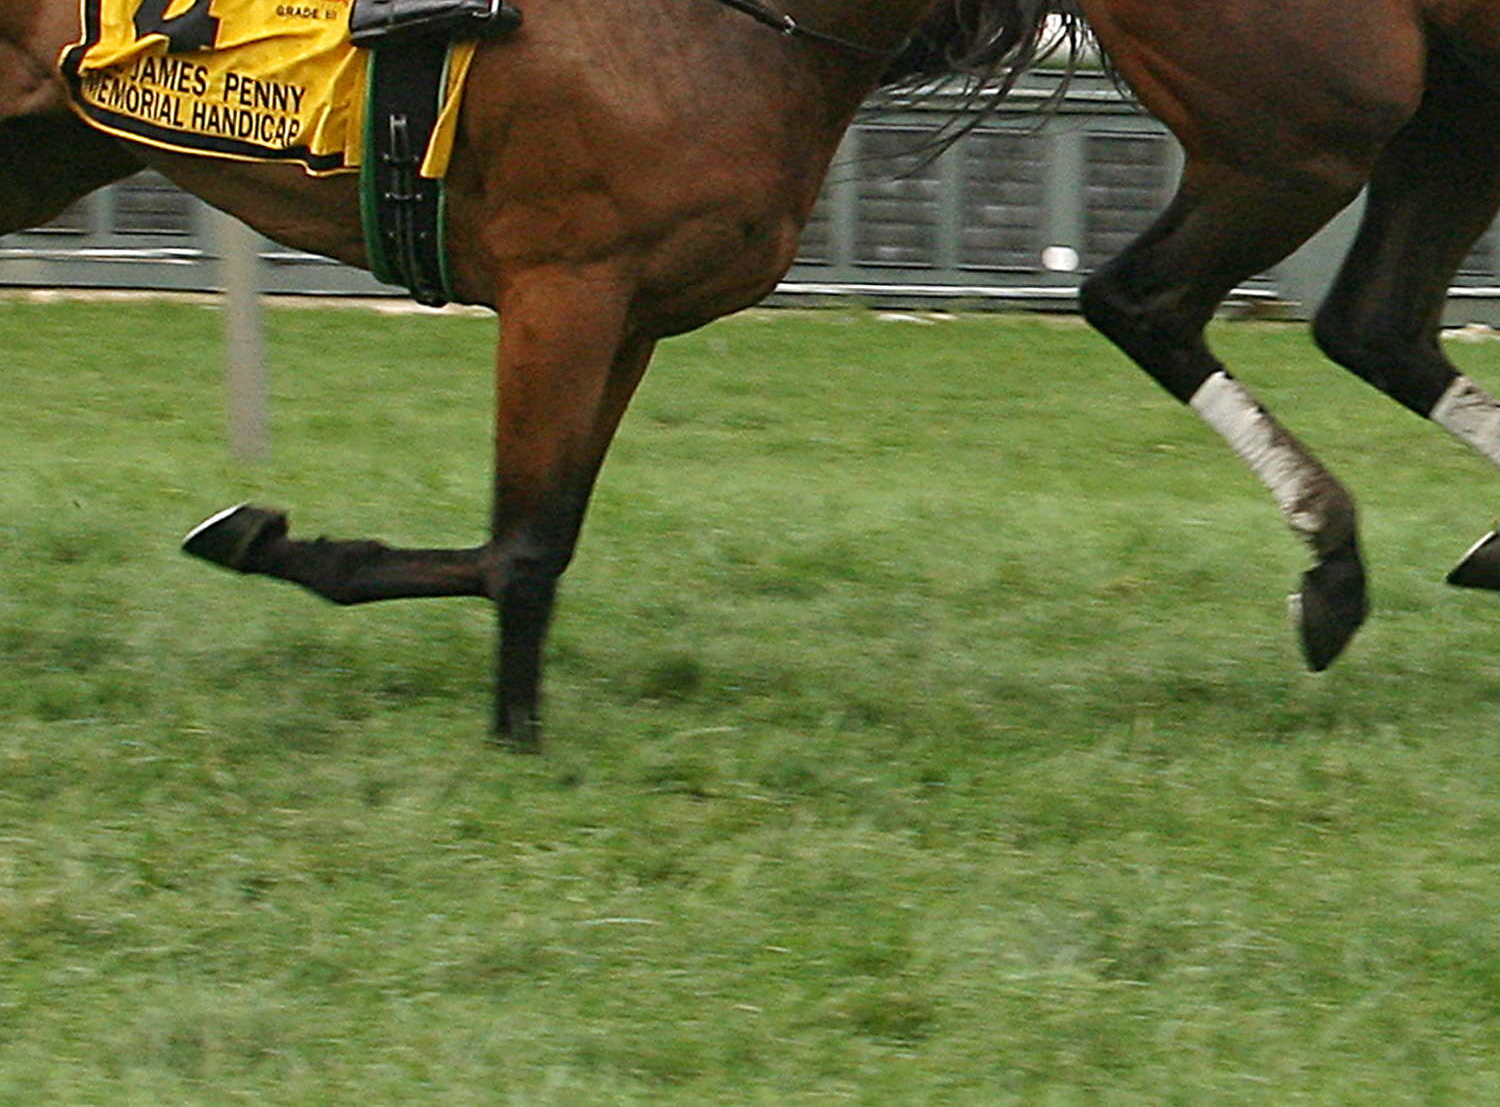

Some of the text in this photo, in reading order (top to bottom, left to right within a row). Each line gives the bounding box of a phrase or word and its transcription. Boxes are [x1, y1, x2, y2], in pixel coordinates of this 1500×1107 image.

[130, 56, 306, 113] JAMES PENNY
[192, 101, 301, 148] HANDICAP
